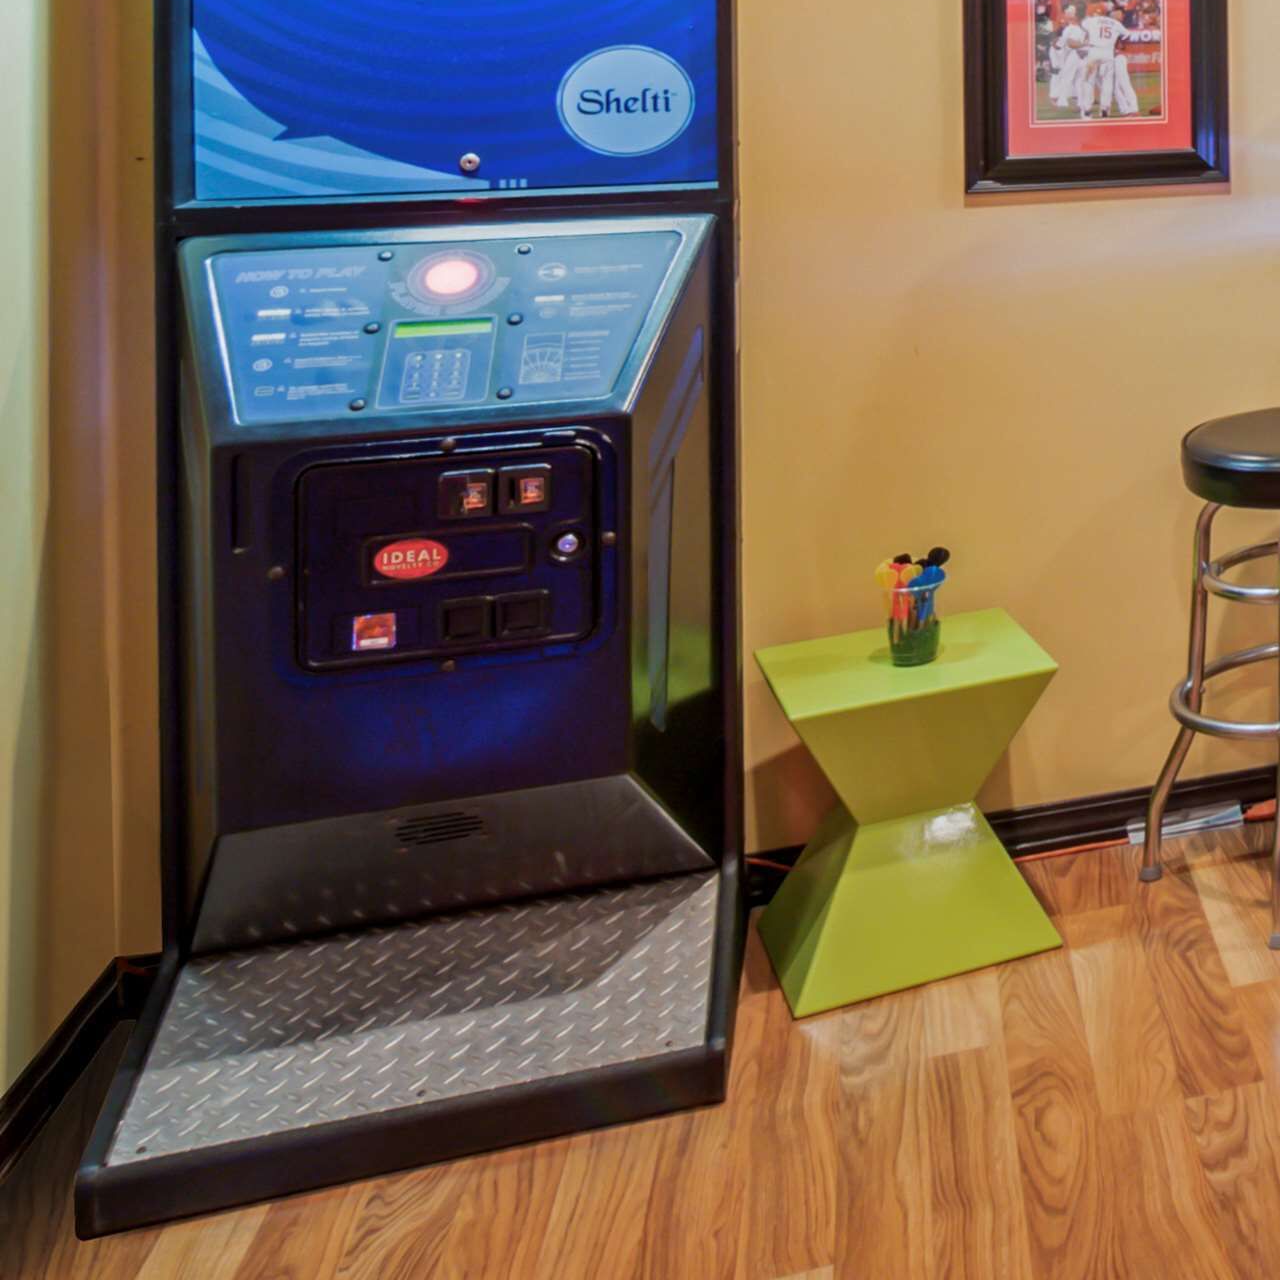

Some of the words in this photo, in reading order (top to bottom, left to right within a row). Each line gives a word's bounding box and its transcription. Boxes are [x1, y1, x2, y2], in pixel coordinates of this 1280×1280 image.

[577, 88, 672, 116] Shelti
[236, 270, 284, 284] HOW
[288, 268, 314, 281] TO
[315, 265, 367, 279] PLAY
[382, 548, 441, 565] IDEAL
